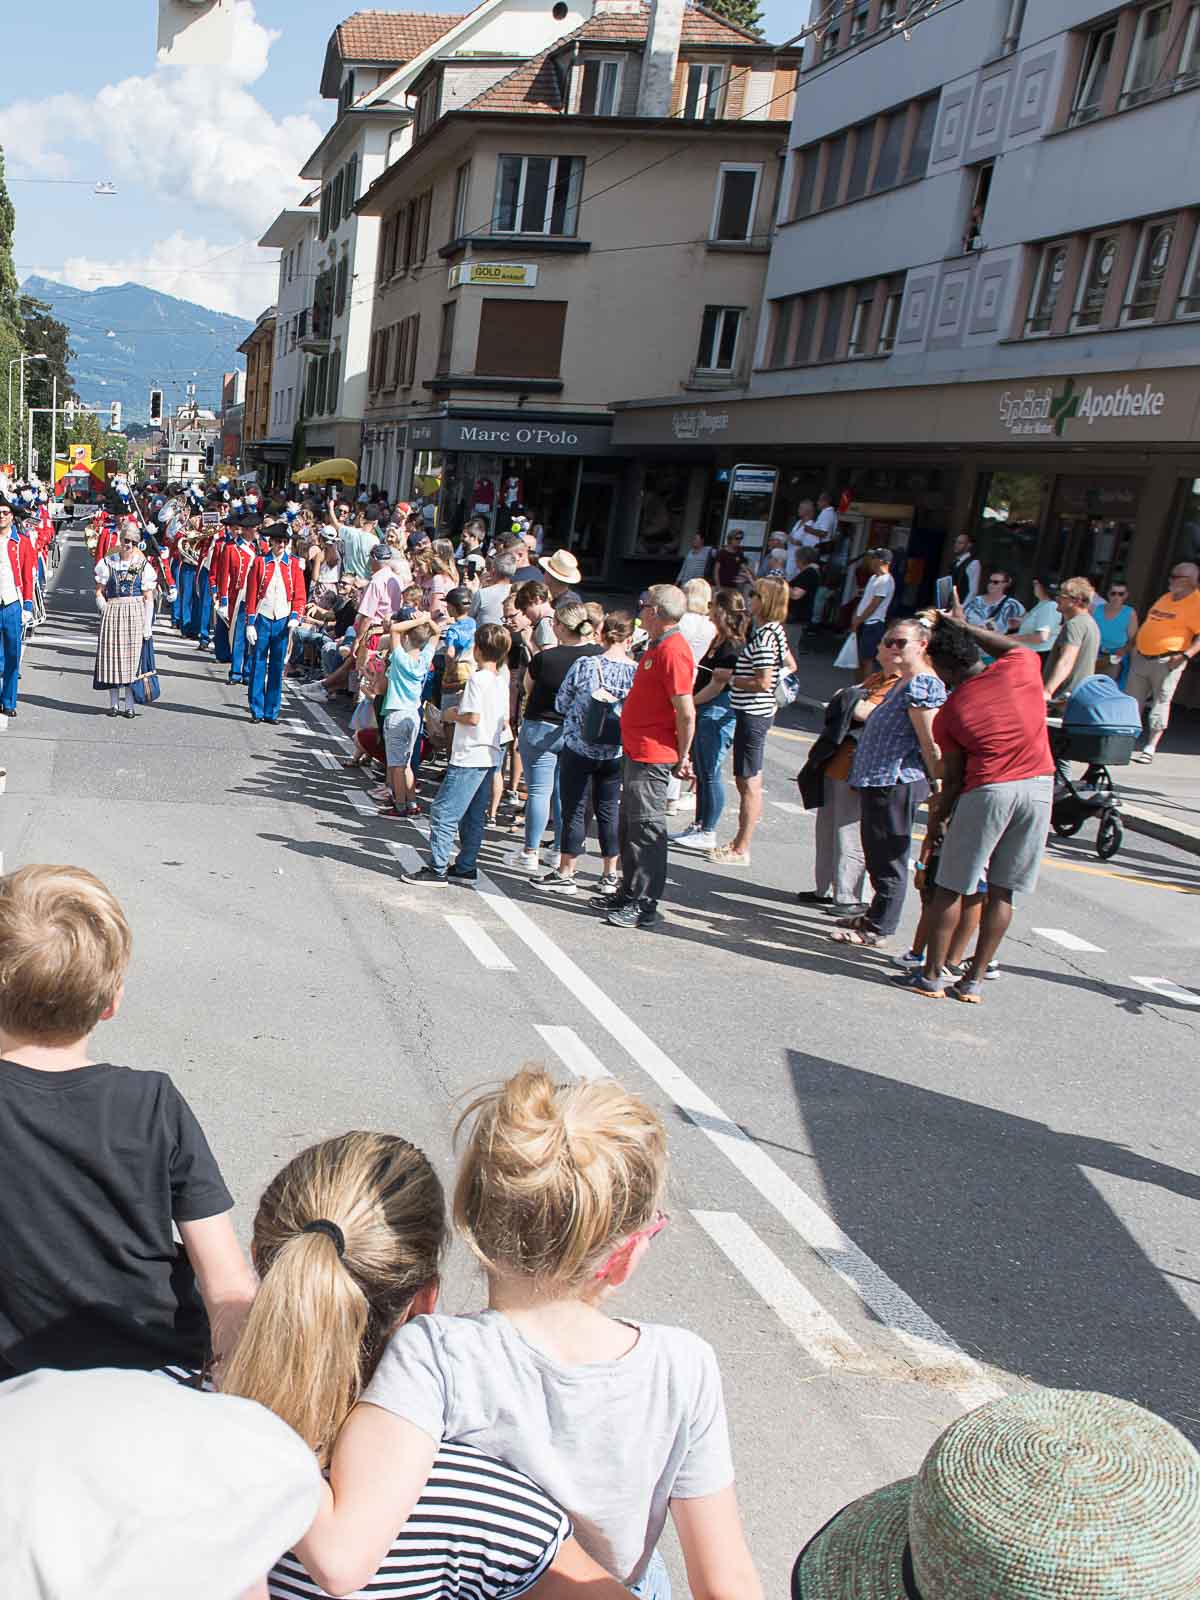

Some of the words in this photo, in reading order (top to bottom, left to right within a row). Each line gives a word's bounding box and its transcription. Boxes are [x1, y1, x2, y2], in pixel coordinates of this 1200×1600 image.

[475, 267, 501, 276] GOLD
[1078, 384, 1164, 424] Apotheke
[460, 426, 510, 442] Marc
[516, 429, 578, 444] O'Polo
[719, 471, 728, 479] A
